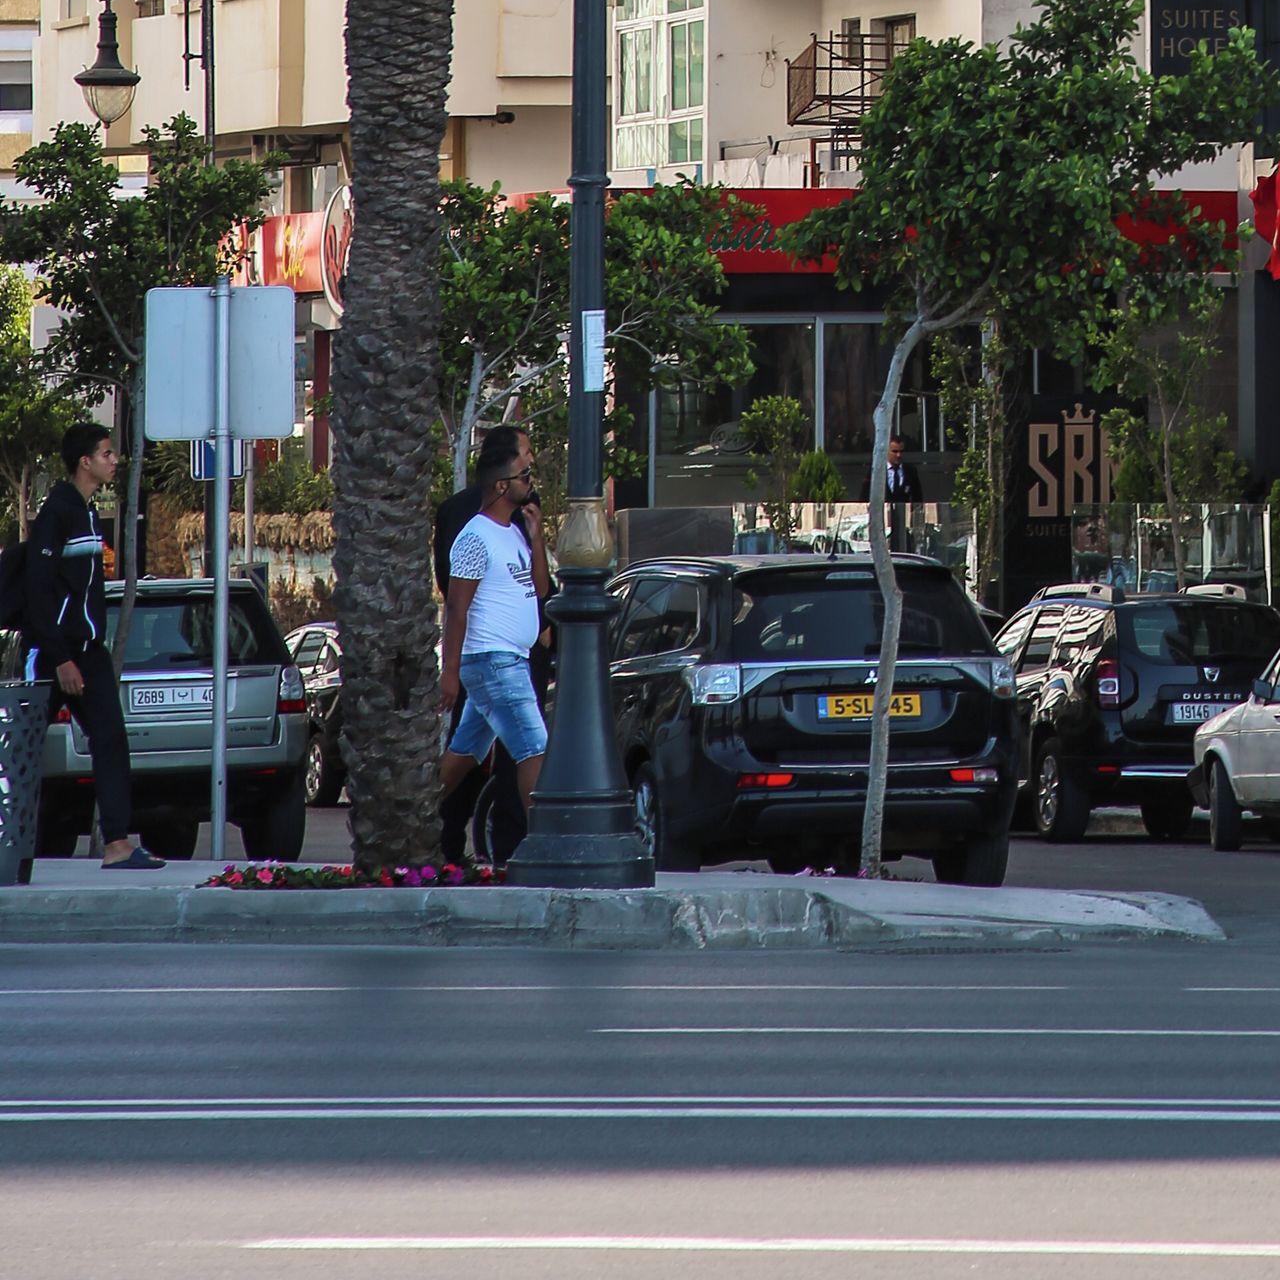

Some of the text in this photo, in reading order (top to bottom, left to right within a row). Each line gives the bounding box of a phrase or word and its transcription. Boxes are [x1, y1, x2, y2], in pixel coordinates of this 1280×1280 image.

[1161, 10, 1240, 29] SUITES
[137, 690, 165, 704] 2689
[1182, 692, 1242, 700] DUSTER
[1180, 705, 1209, 719] 19146
